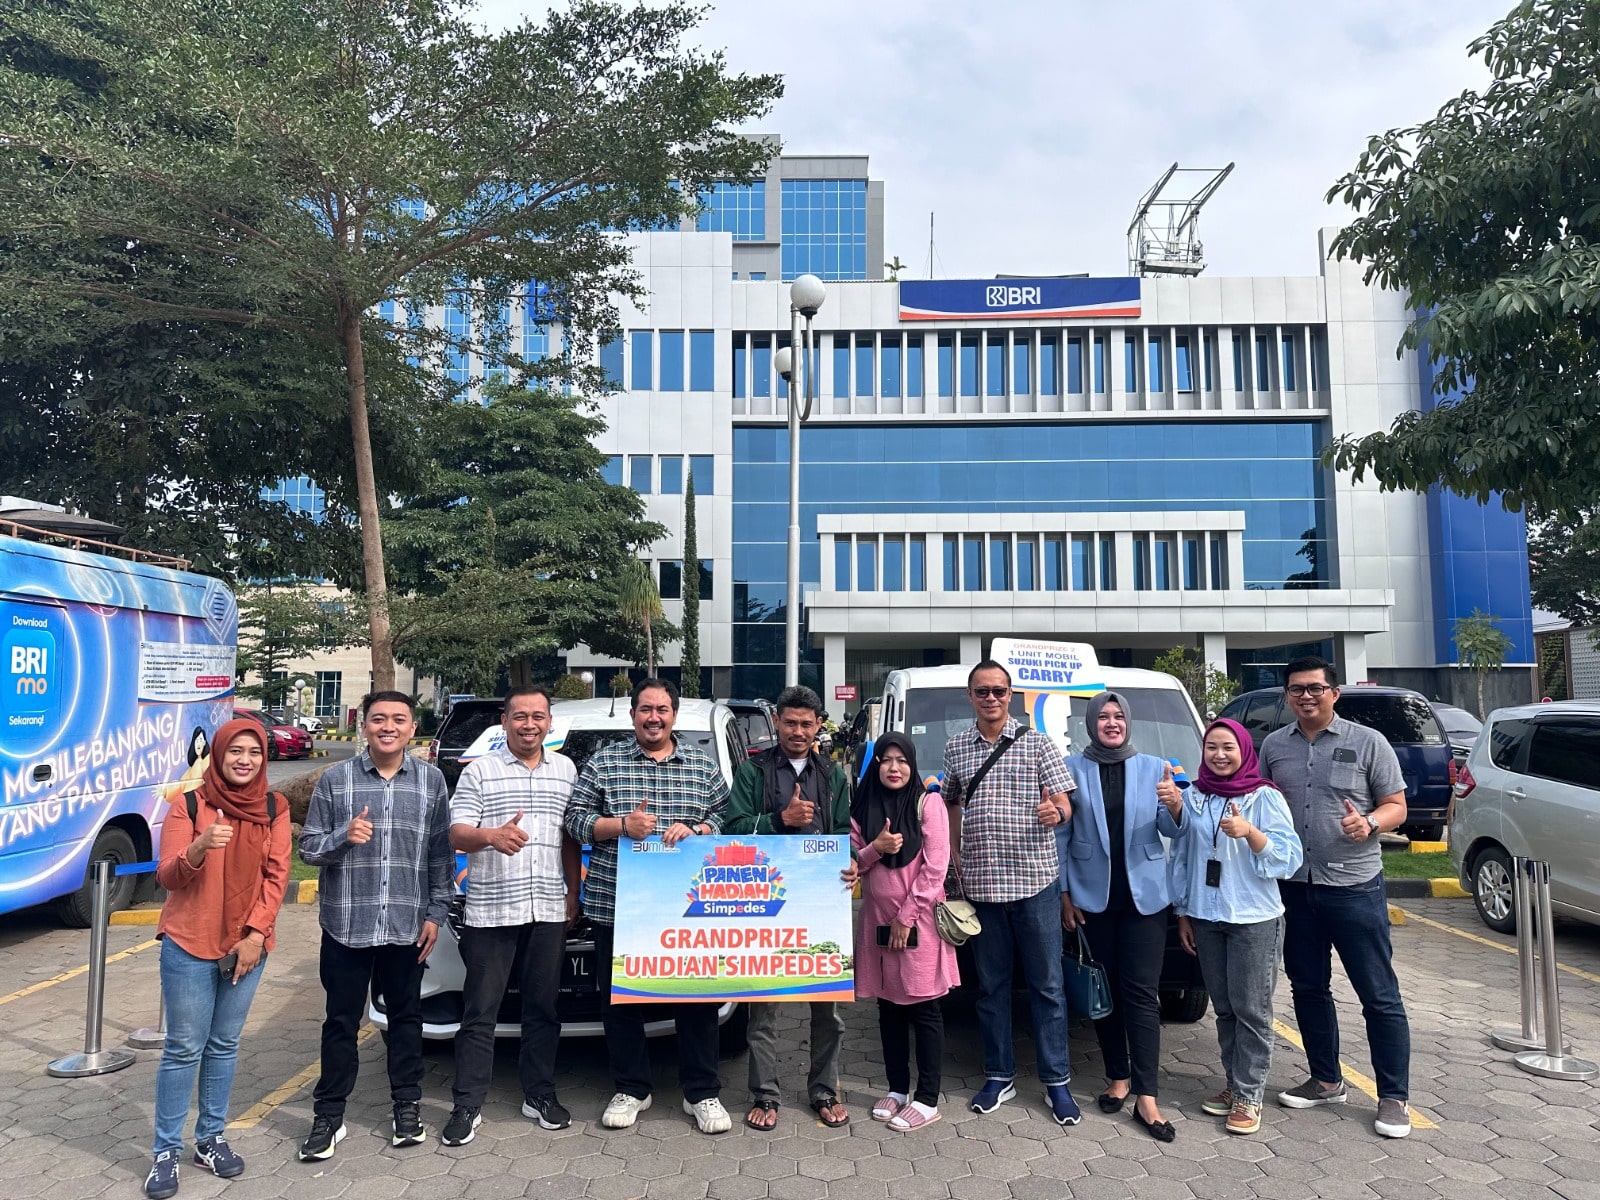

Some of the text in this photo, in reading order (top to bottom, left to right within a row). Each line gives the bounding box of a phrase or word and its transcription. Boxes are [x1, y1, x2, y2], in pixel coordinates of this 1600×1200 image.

[1008, 286, 1041, 305] BRI
[12, 615, 48, 628] Download
[1013, 643, 1068, 652] GRANDPRIZE
[1018, 650, 1042, 658] UNIT
[1045, 652, 1080, 661] MOBIL
[11, 646, 48, 675] BRI
[1008, 657, 1083, 670] SUZUKI PICK UP
[1018, 667, 1073, 683] CARRY
[16, 677, 48, 695] mo
[9, 715, 45, 726] Sekarang!
[4, 713, 175, 803] MOBILE BANKING
[67, 774, 106, 815] PAS
[111, 741, 186, 792] BUATMU!
[817, 840, 839, 853] BRI
[704, 866, 768, 884] PANEN
[699, 883, 770, 900] HADIAH
[703, 902, 766, 916] Simpedes
[660, 927, 808, 949] GRANDPRIZE
[571, 957, 589, 976] YL
[625, 954, 842, 977] UNDIAN SIMPEDES
